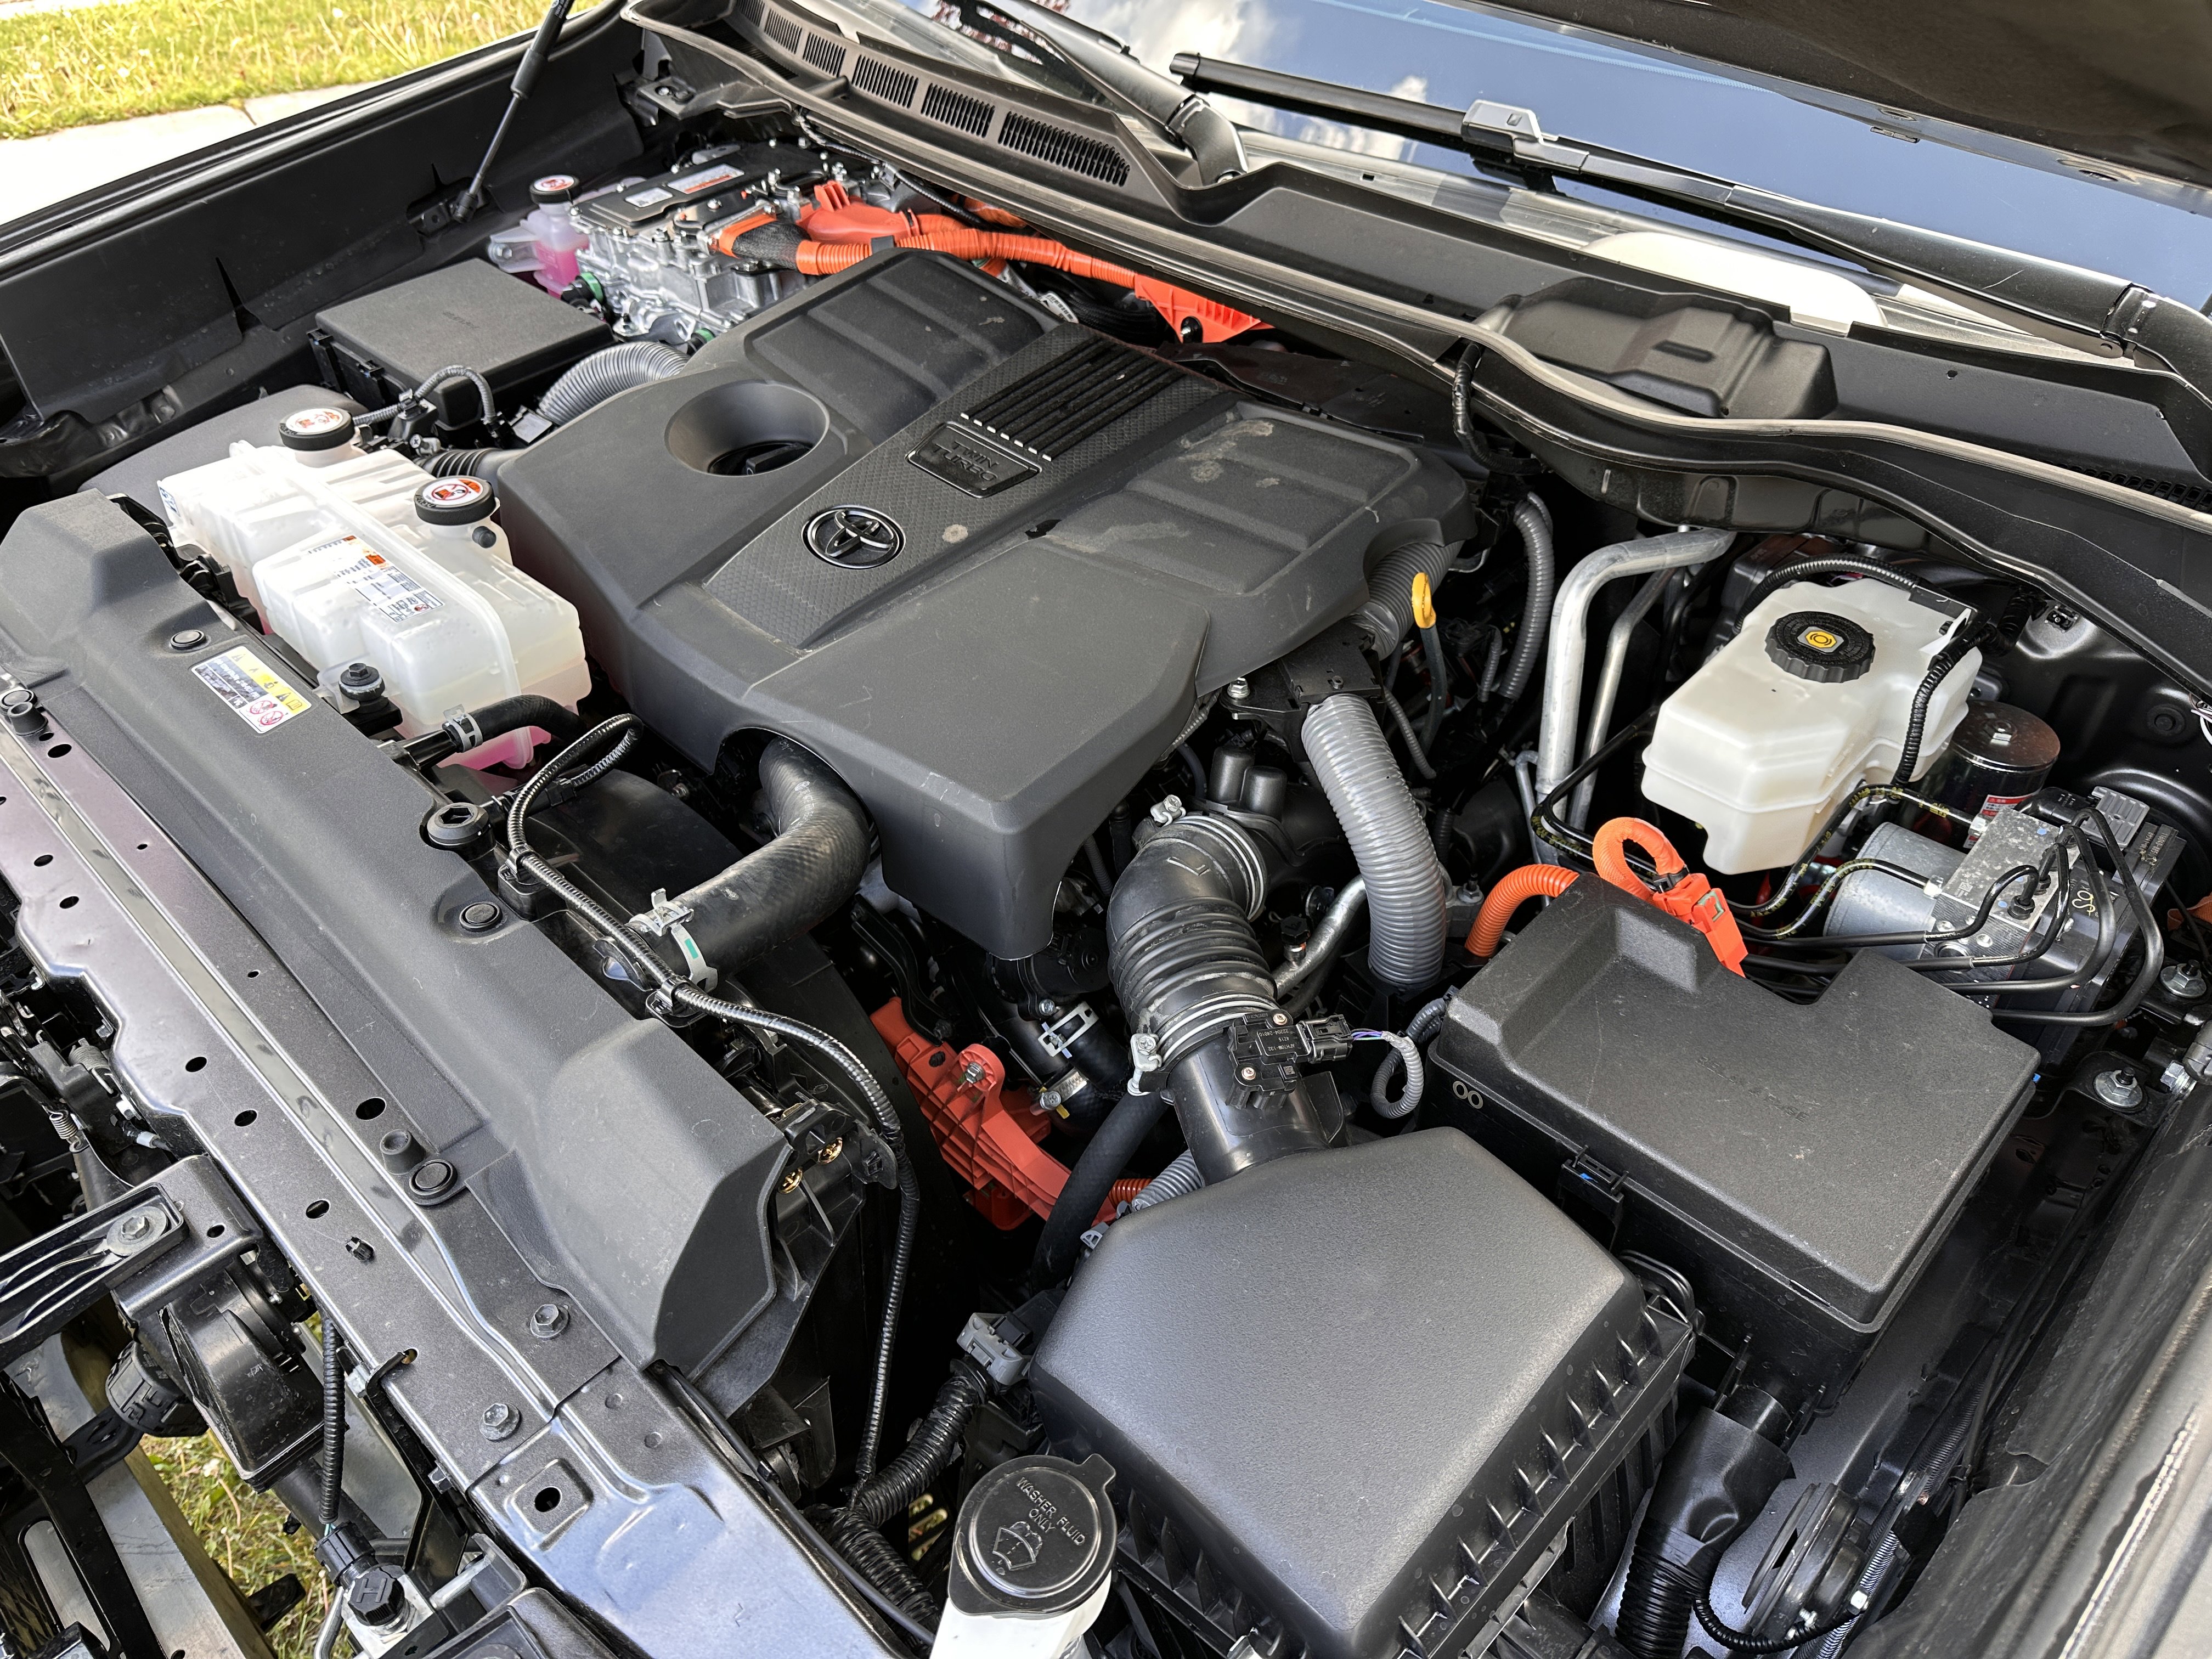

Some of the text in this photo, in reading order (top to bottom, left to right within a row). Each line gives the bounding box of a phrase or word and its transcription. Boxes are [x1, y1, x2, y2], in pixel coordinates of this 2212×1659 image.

[934, 443, 998, 481] TURBO
[953, 440, 999, 469] TWIN
[1017, 1477, 1086, 1545] WASHER FLUID
[1029, 1508, 1057, 1533] ONLY
